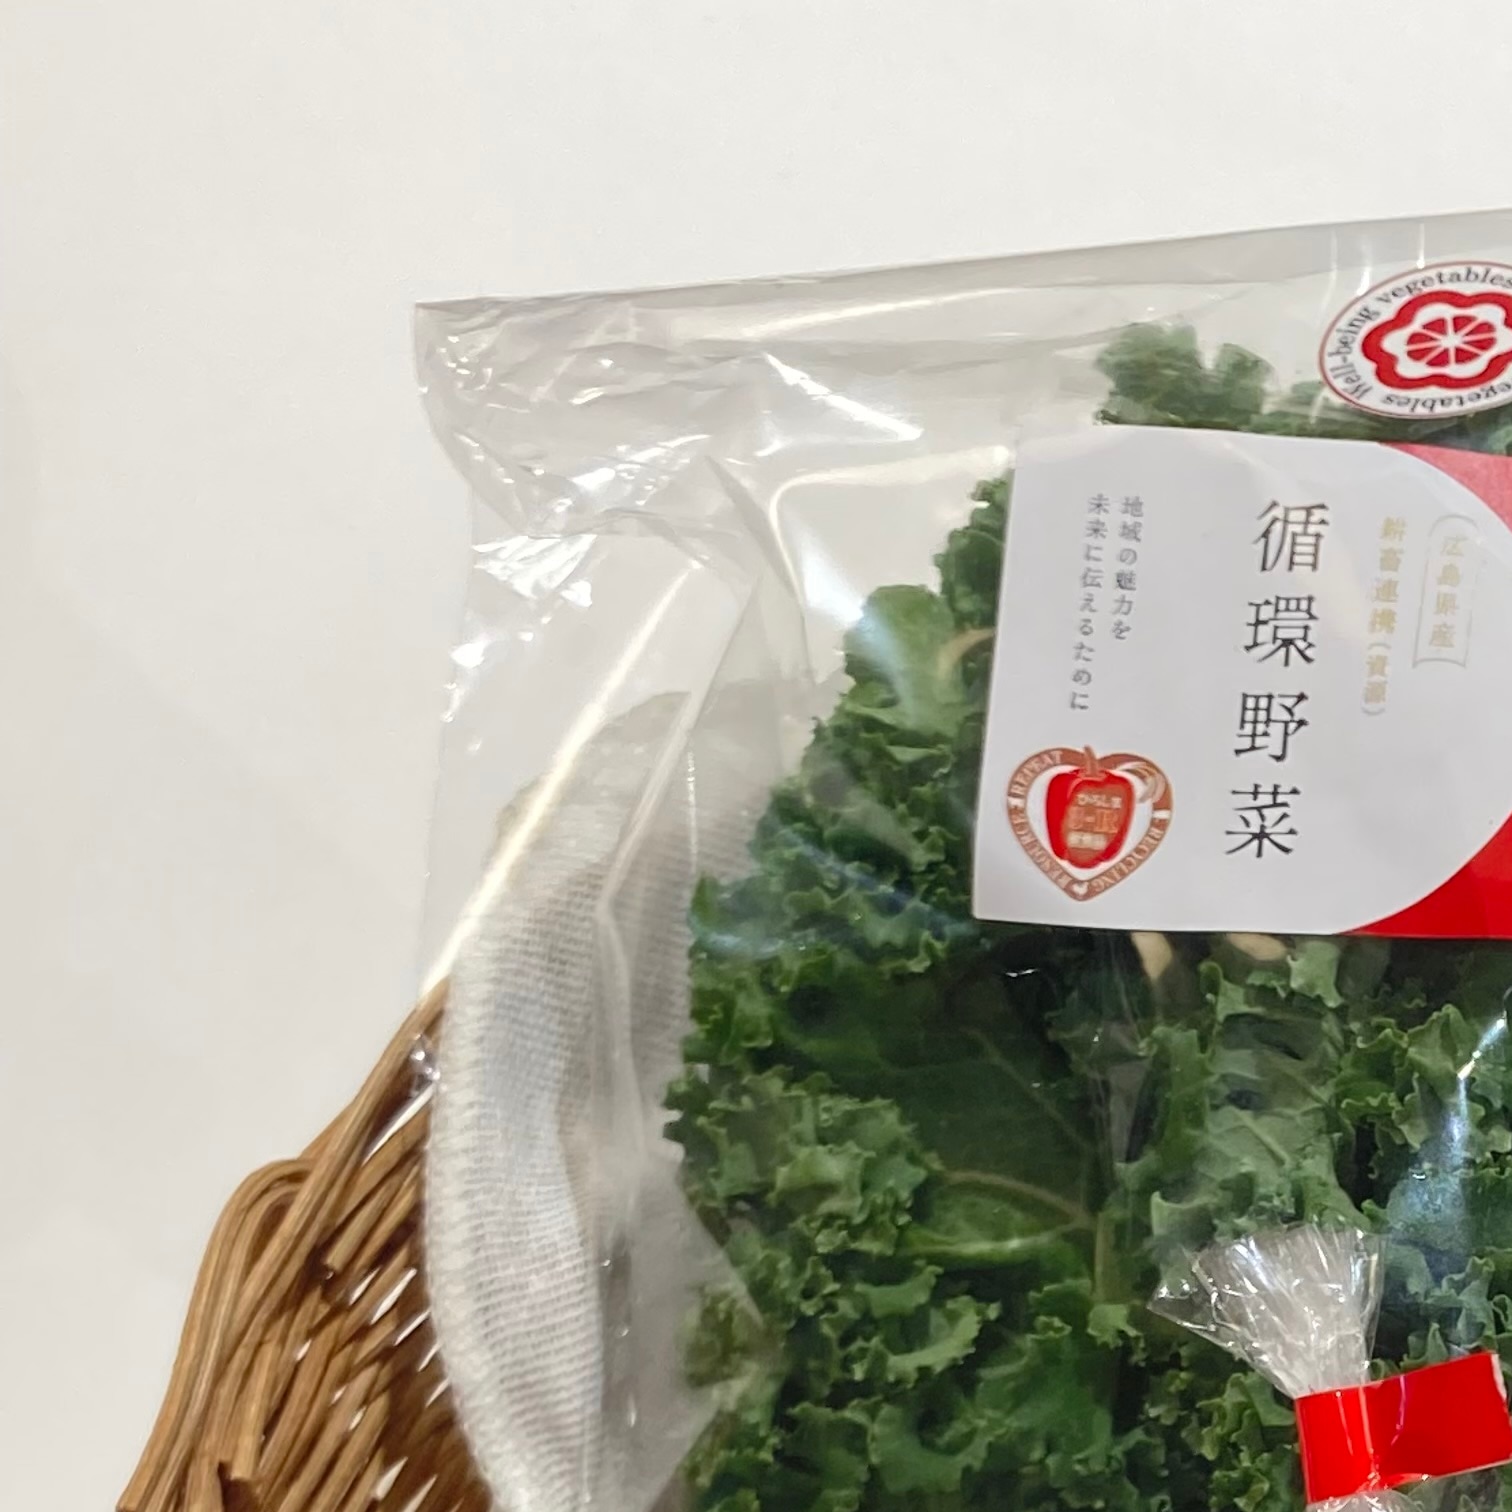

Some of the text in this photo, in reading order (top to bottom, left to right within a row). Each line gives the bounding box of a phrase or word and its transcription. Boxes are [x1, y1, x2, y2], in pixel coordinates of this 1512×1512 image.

[1327, 306, 1380, 400] Well-being
[1112, 495, 1143, 640] 地域の魅力を
[1225, 498, 1329, 858] 循環野菜
